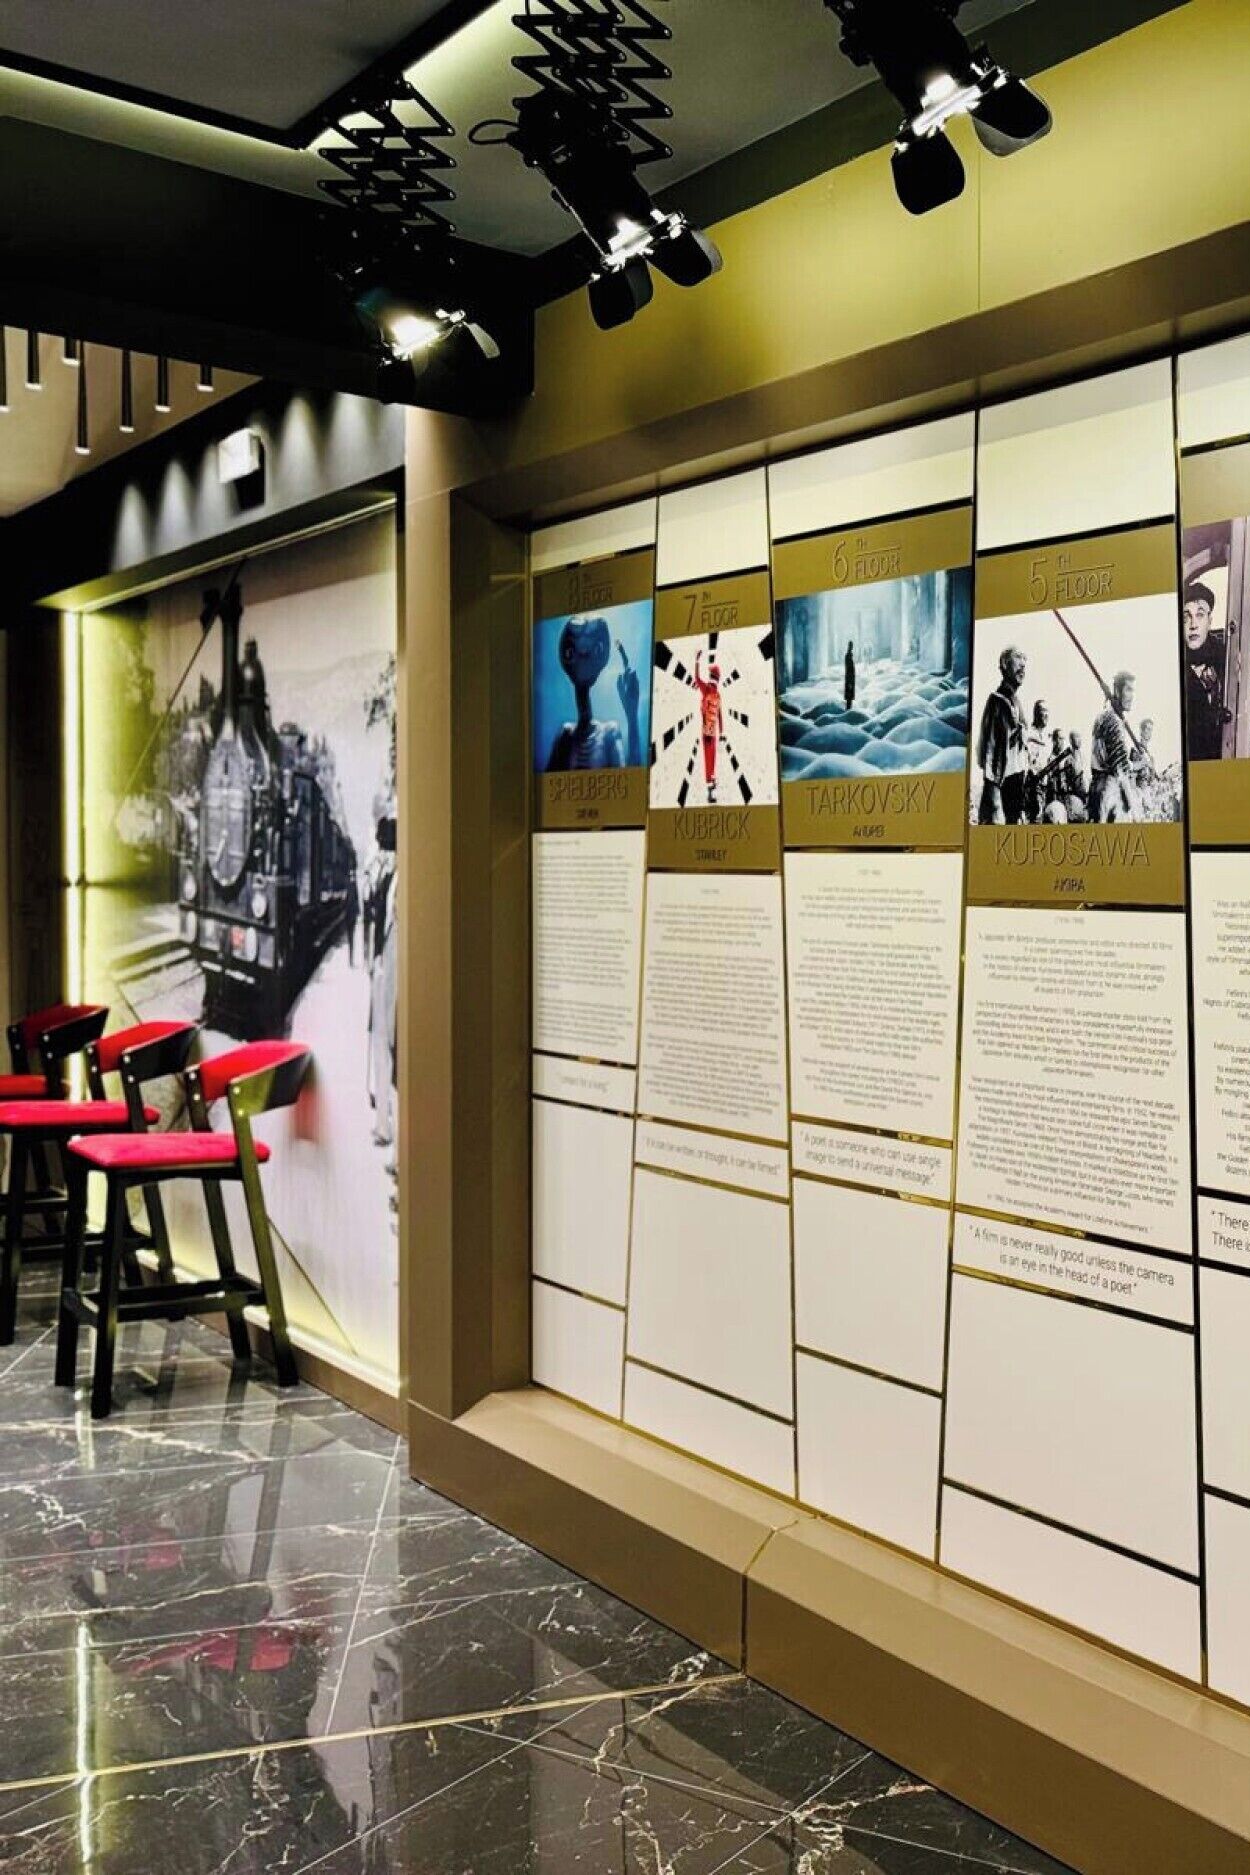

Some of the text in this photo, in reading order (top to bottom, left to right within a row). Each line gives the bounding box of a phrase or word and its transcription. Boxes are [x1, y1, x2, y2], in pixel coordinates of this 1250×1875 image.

[832, 539, 901, 583] 6 FLOOR
[1029, 556, 1112, 605] 5 FLOOR
[683, 594, 697, 632] 7
[806, 780, 935, 816] TARKOVSKY
[674, 811, 751, 840] KUBRICK
[995, 830, 1150, 867] KUROSAWA
[1219, 1212, 1249, 1230] There
[1212, 1231, 1242, 1250] There
